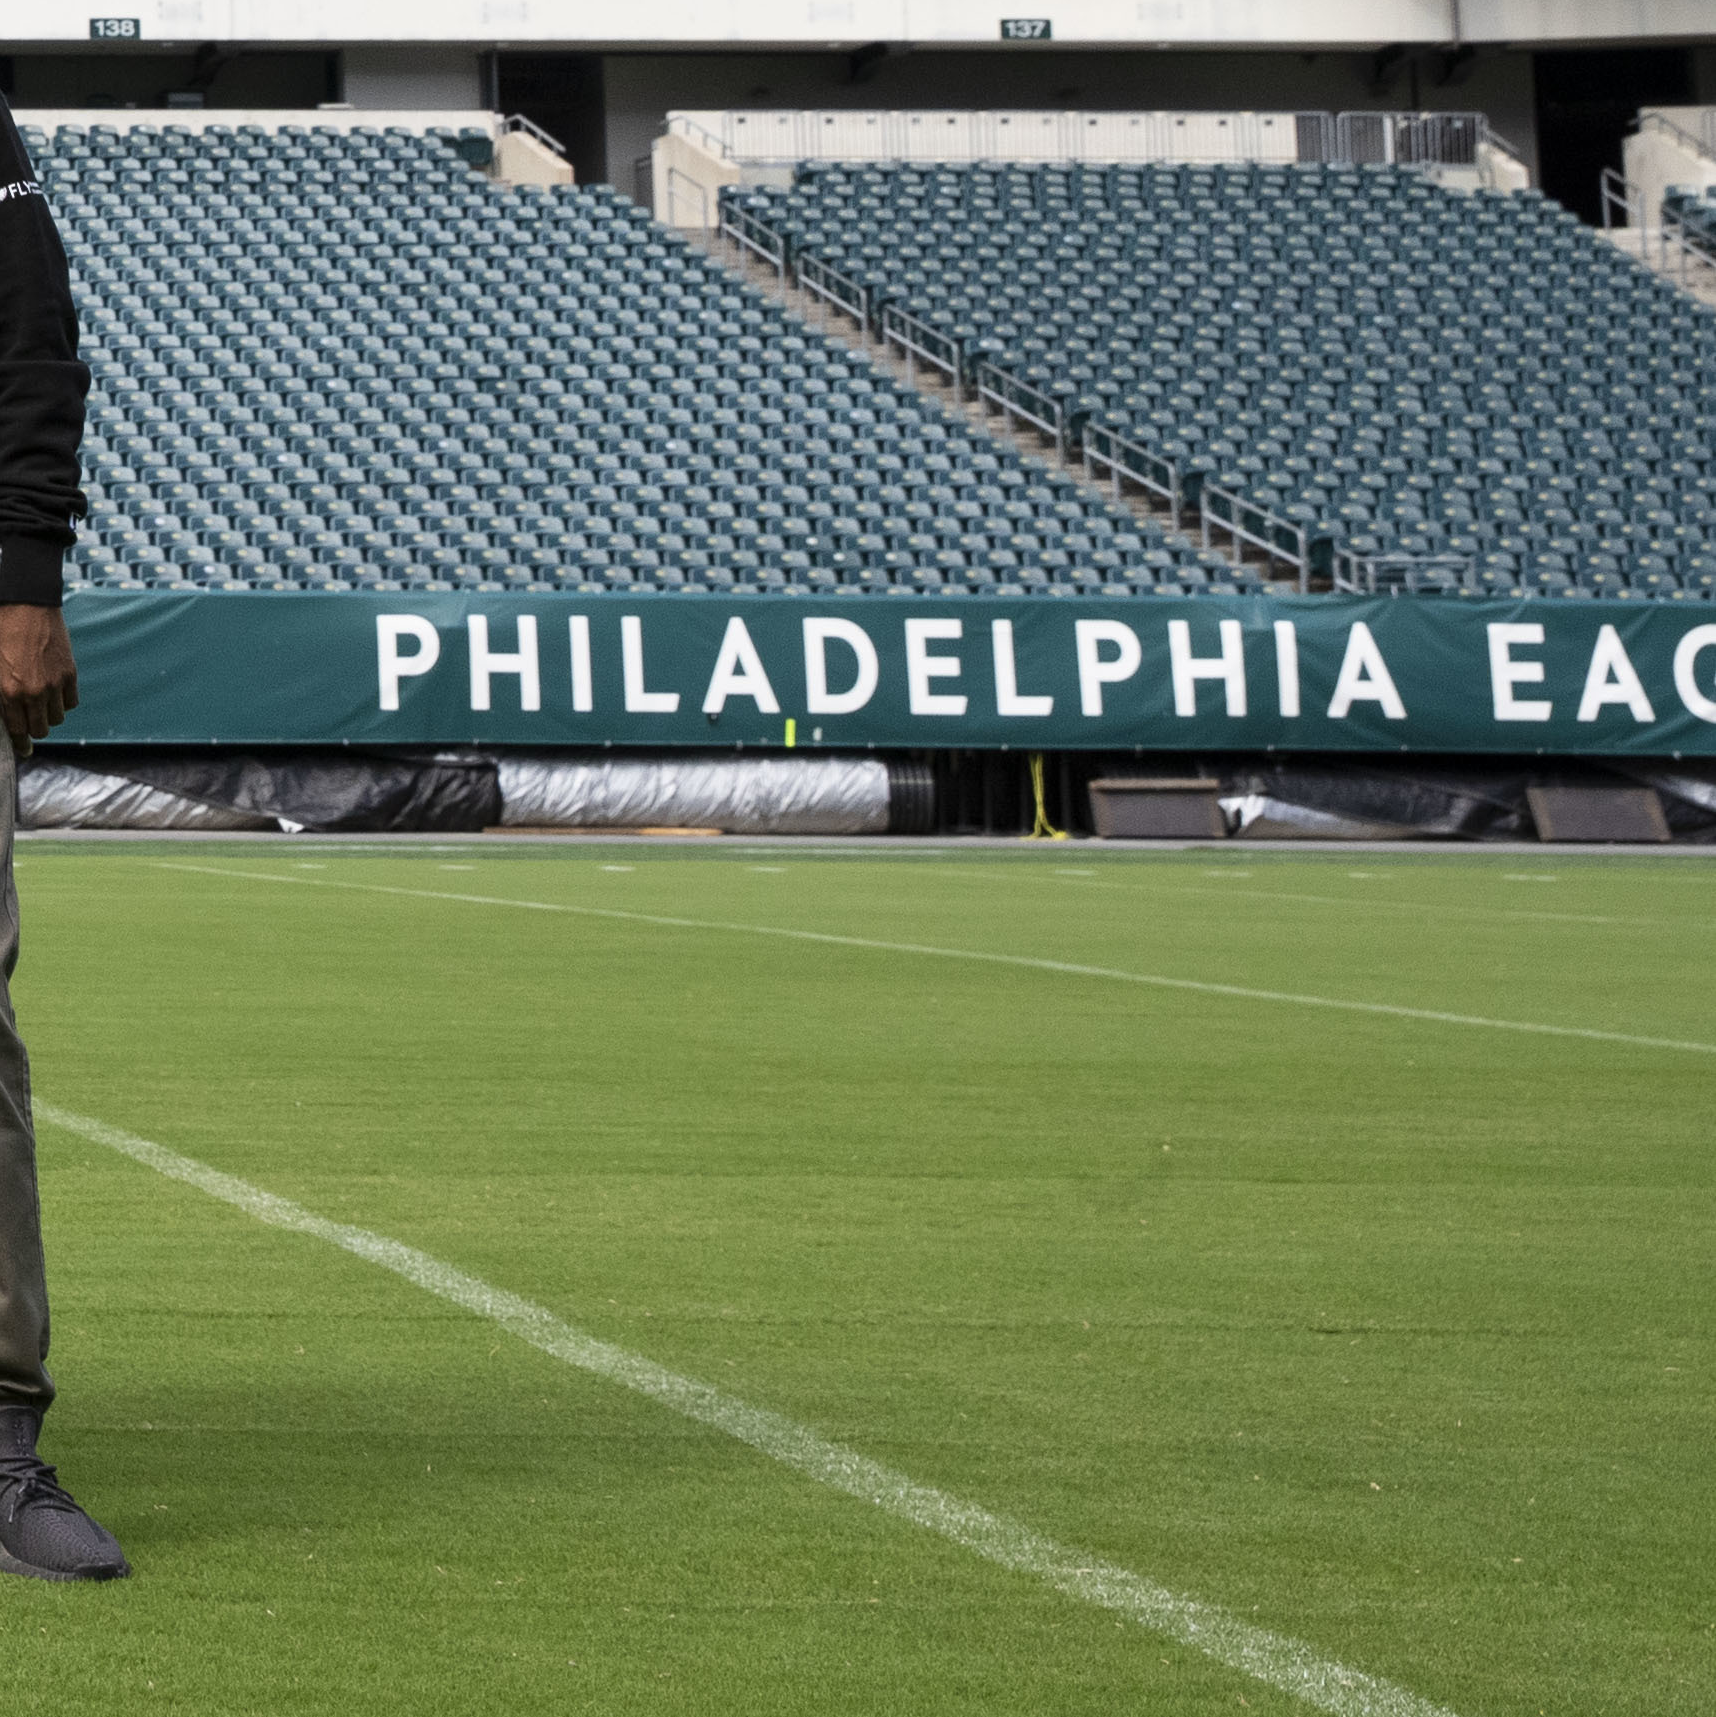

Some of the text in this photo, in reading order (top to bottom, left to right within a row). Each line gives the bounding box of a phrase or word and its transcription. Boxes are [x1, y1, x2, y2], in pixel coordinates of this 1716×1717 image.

[94, 19, 136, 37] 138
[1004, 20, 1047, 38] 137
[375, 613, 1407, 719] PHILADELPHIA
